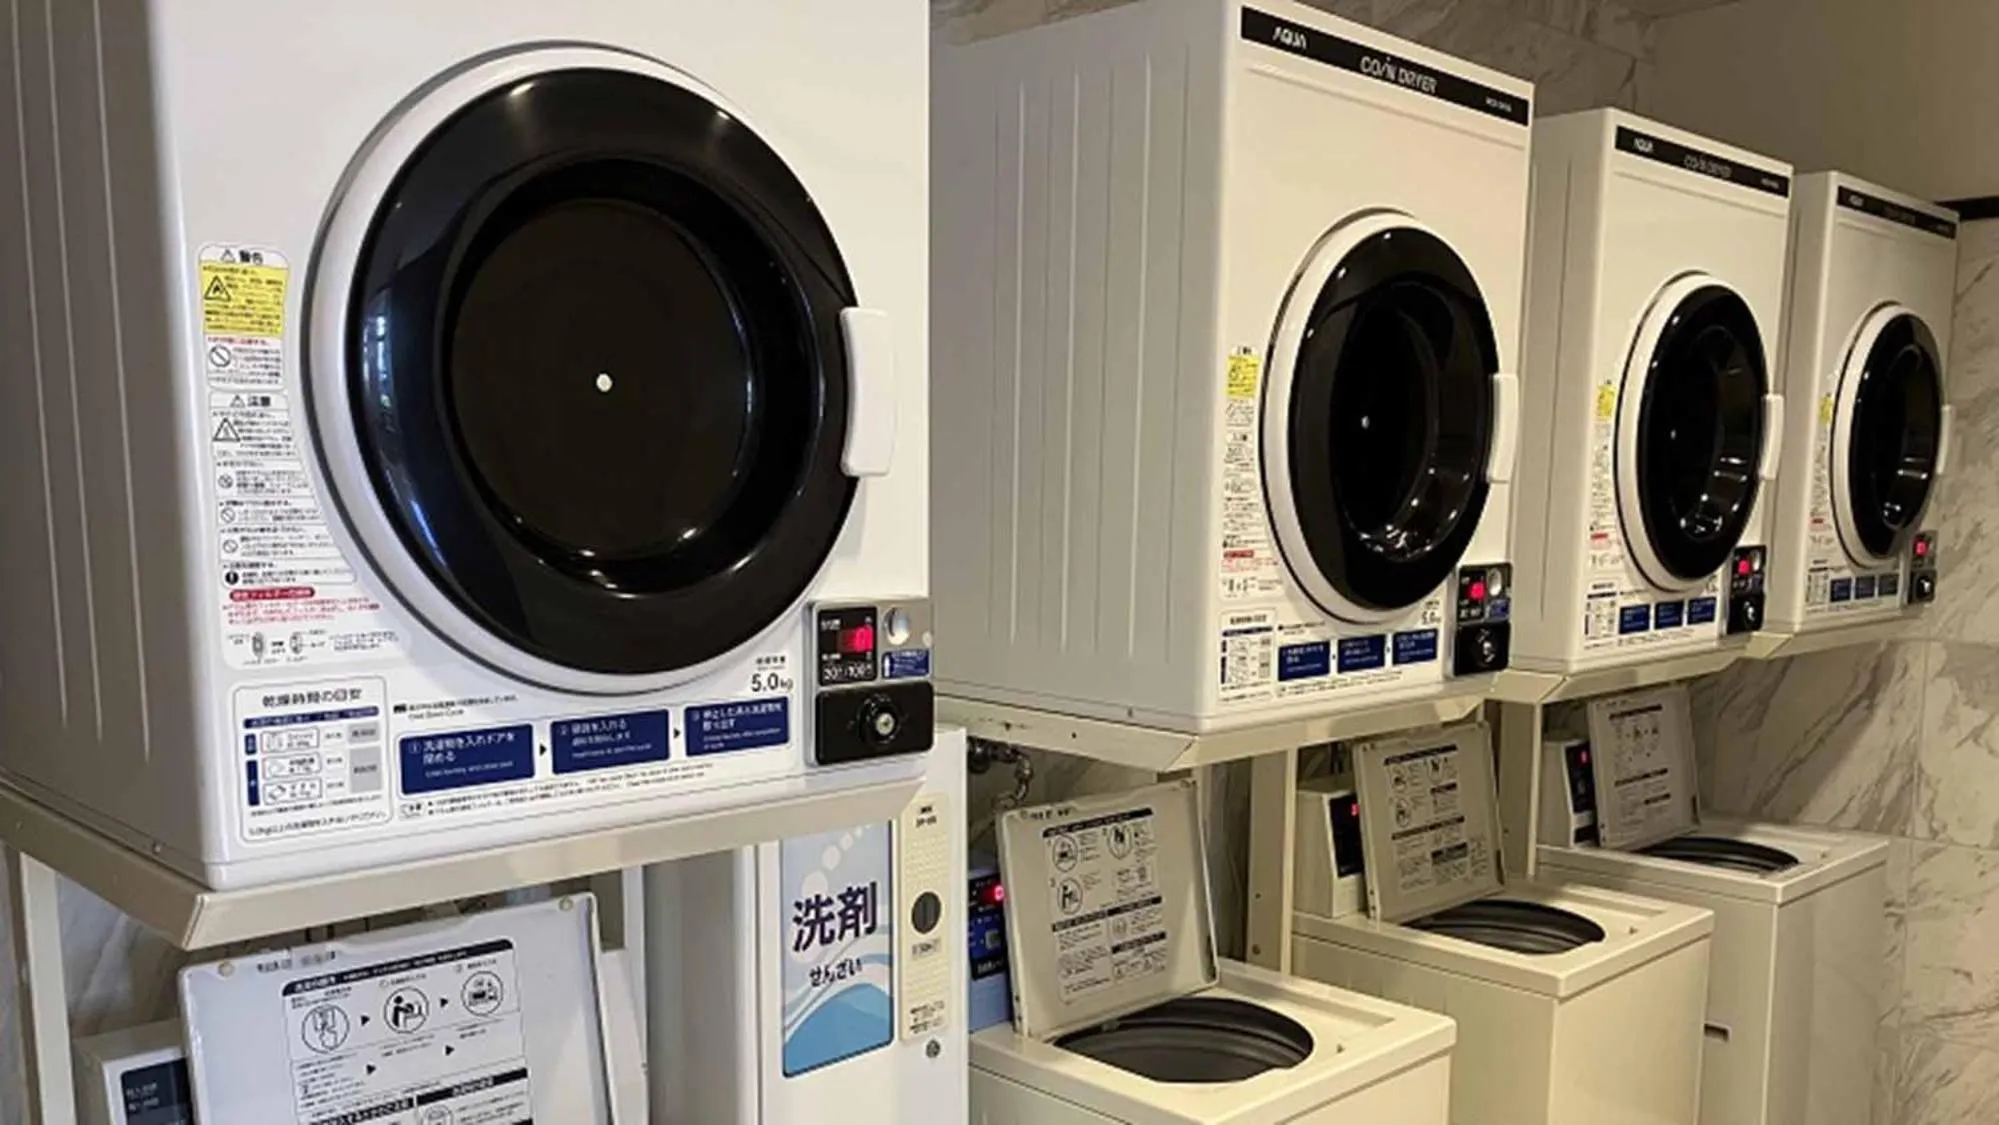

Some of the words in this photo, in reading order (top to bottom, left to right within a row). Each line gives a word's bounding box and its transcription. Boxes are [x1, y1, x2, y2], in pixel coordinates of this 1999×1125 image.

[1272, 25, 1307, 49] AQUA
[1360, 55, 1397, 82] COIN
[1398, 67, 1438, 95] DRYER
[791, 882, 878, 952] 洗剤
[809, 957, 862, 987] せんざい
